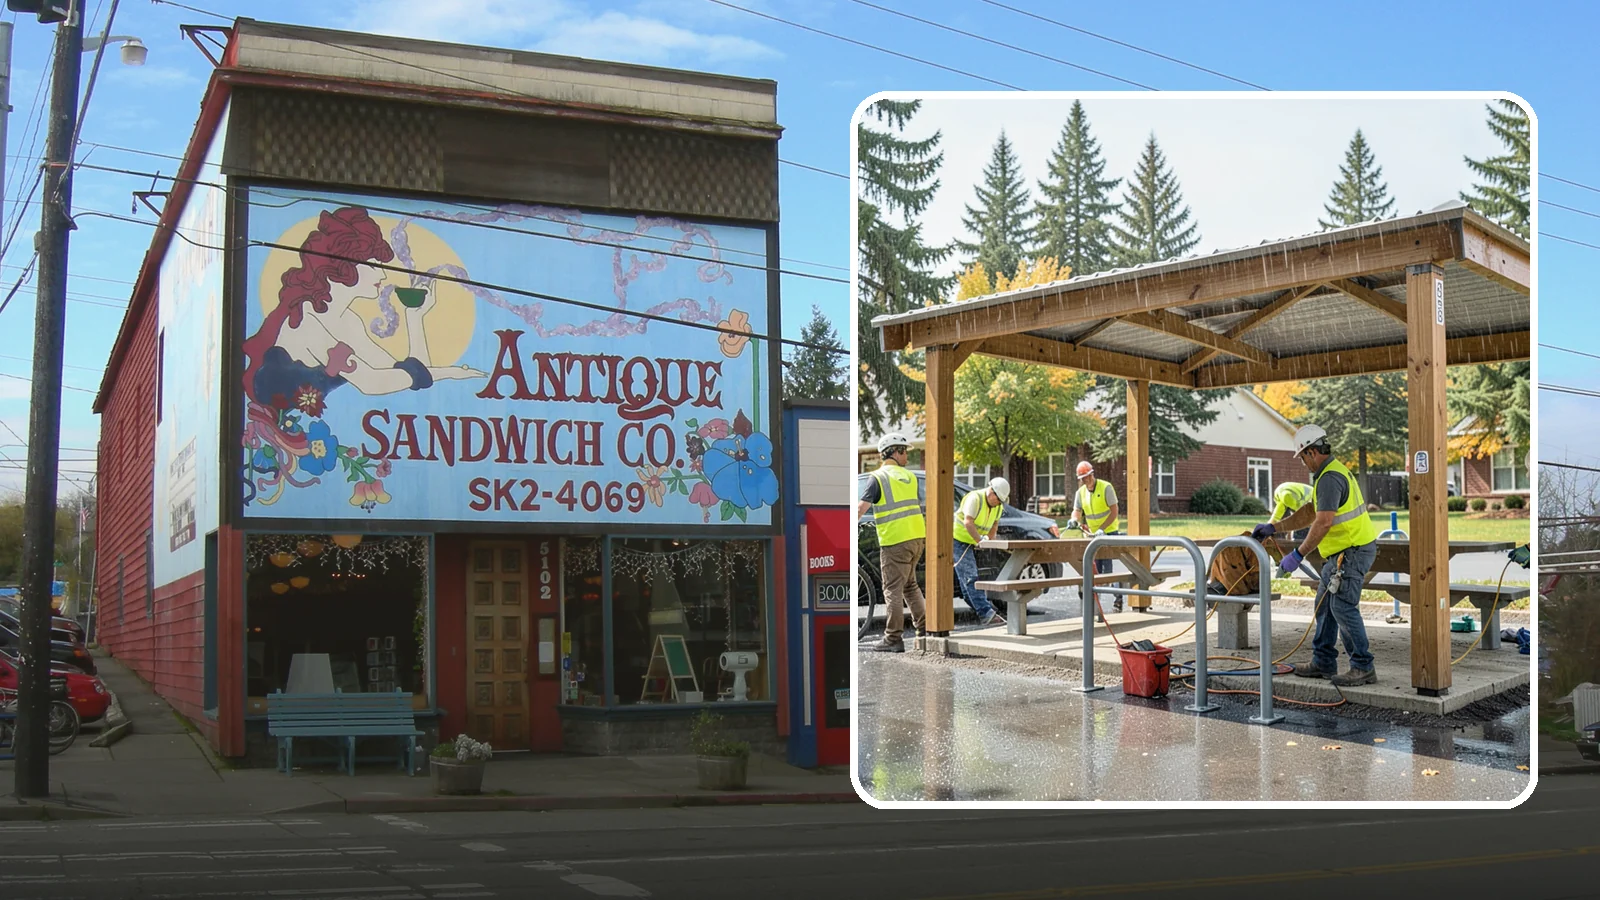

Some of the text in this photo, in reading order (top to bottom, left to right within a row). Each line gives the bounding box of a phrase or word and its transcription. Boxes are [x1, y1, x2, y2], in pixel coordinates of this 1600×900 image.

[476, 329, 723, 420] ANTIQUE
[361, 408, 685, 468] SANDWICH CO.
[468, 477, 645, 512] SK2-4069
[540, 542, 552, 600] 5102
[809, 555, 835, 569] BOOKS
